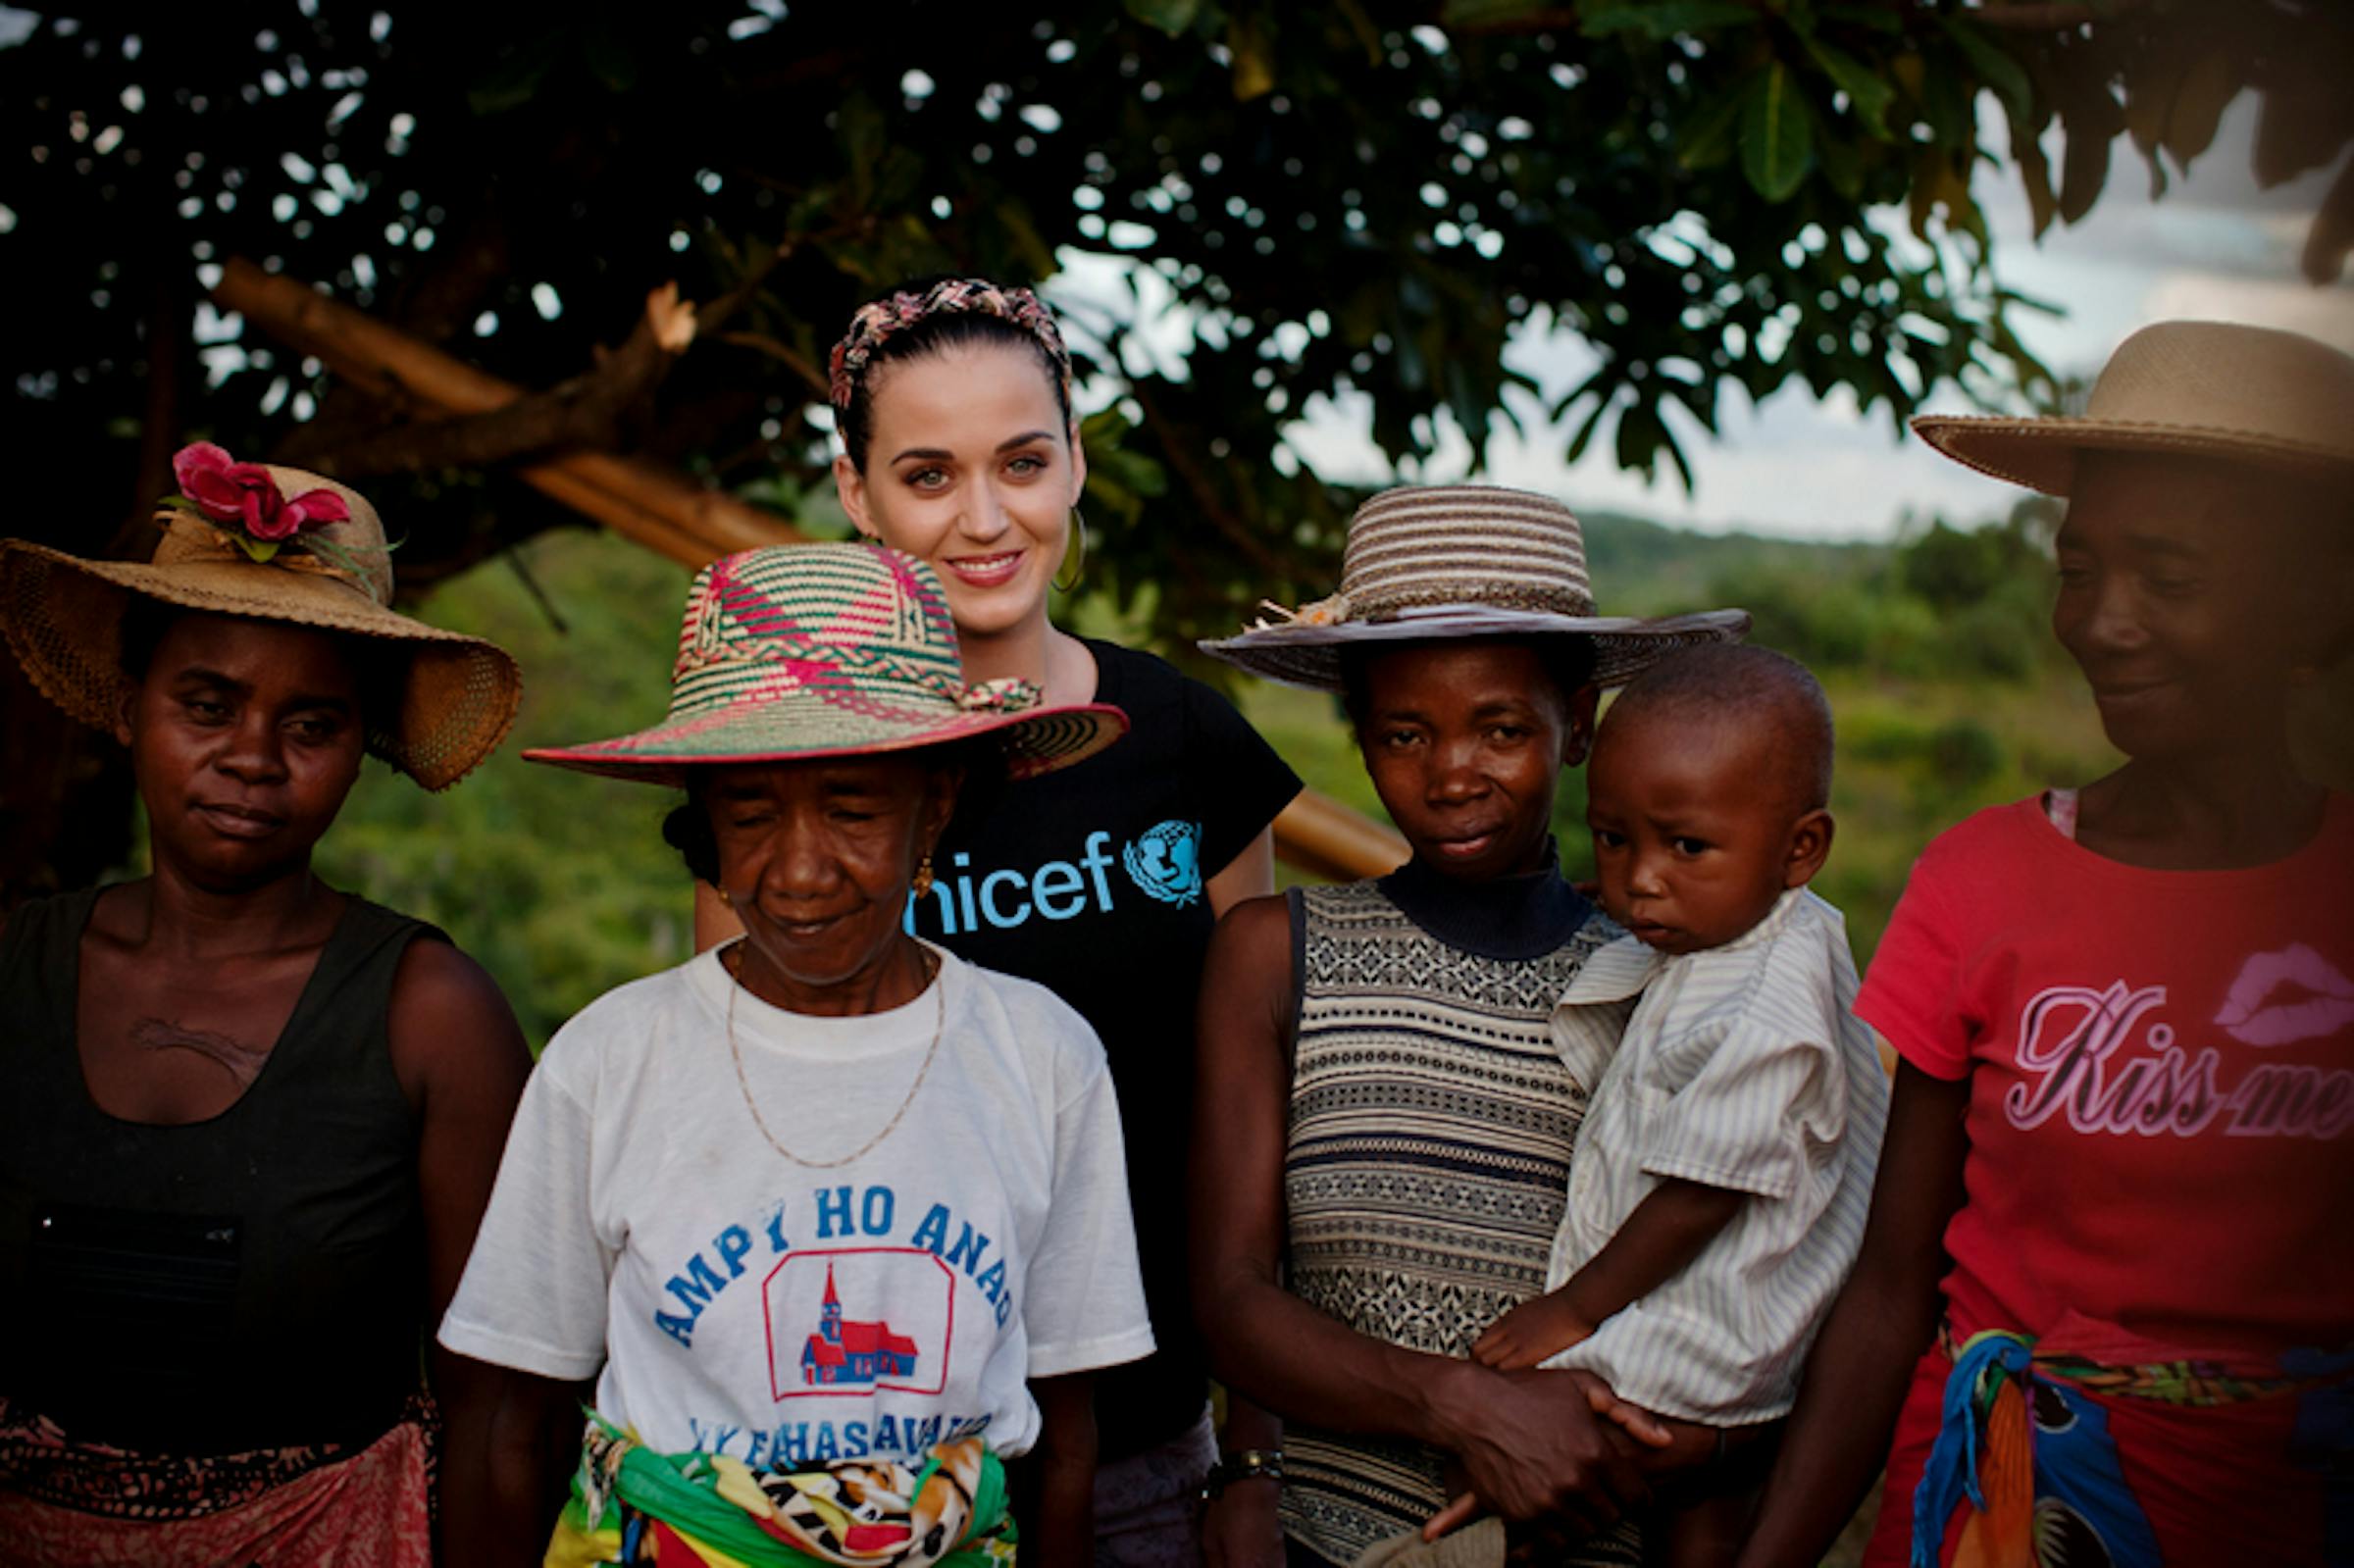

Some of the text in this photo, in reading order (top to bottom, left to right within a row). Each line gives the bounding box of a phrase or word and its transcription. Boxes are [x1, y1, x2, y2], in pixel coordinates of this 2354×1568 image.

[902, 831, 1114, 936] nicef
[2005, 979, 2354, 1139] Kiss me
[654, 1196, 789, 1350] AMPY
[815, 1185, 895, 1239] HO
